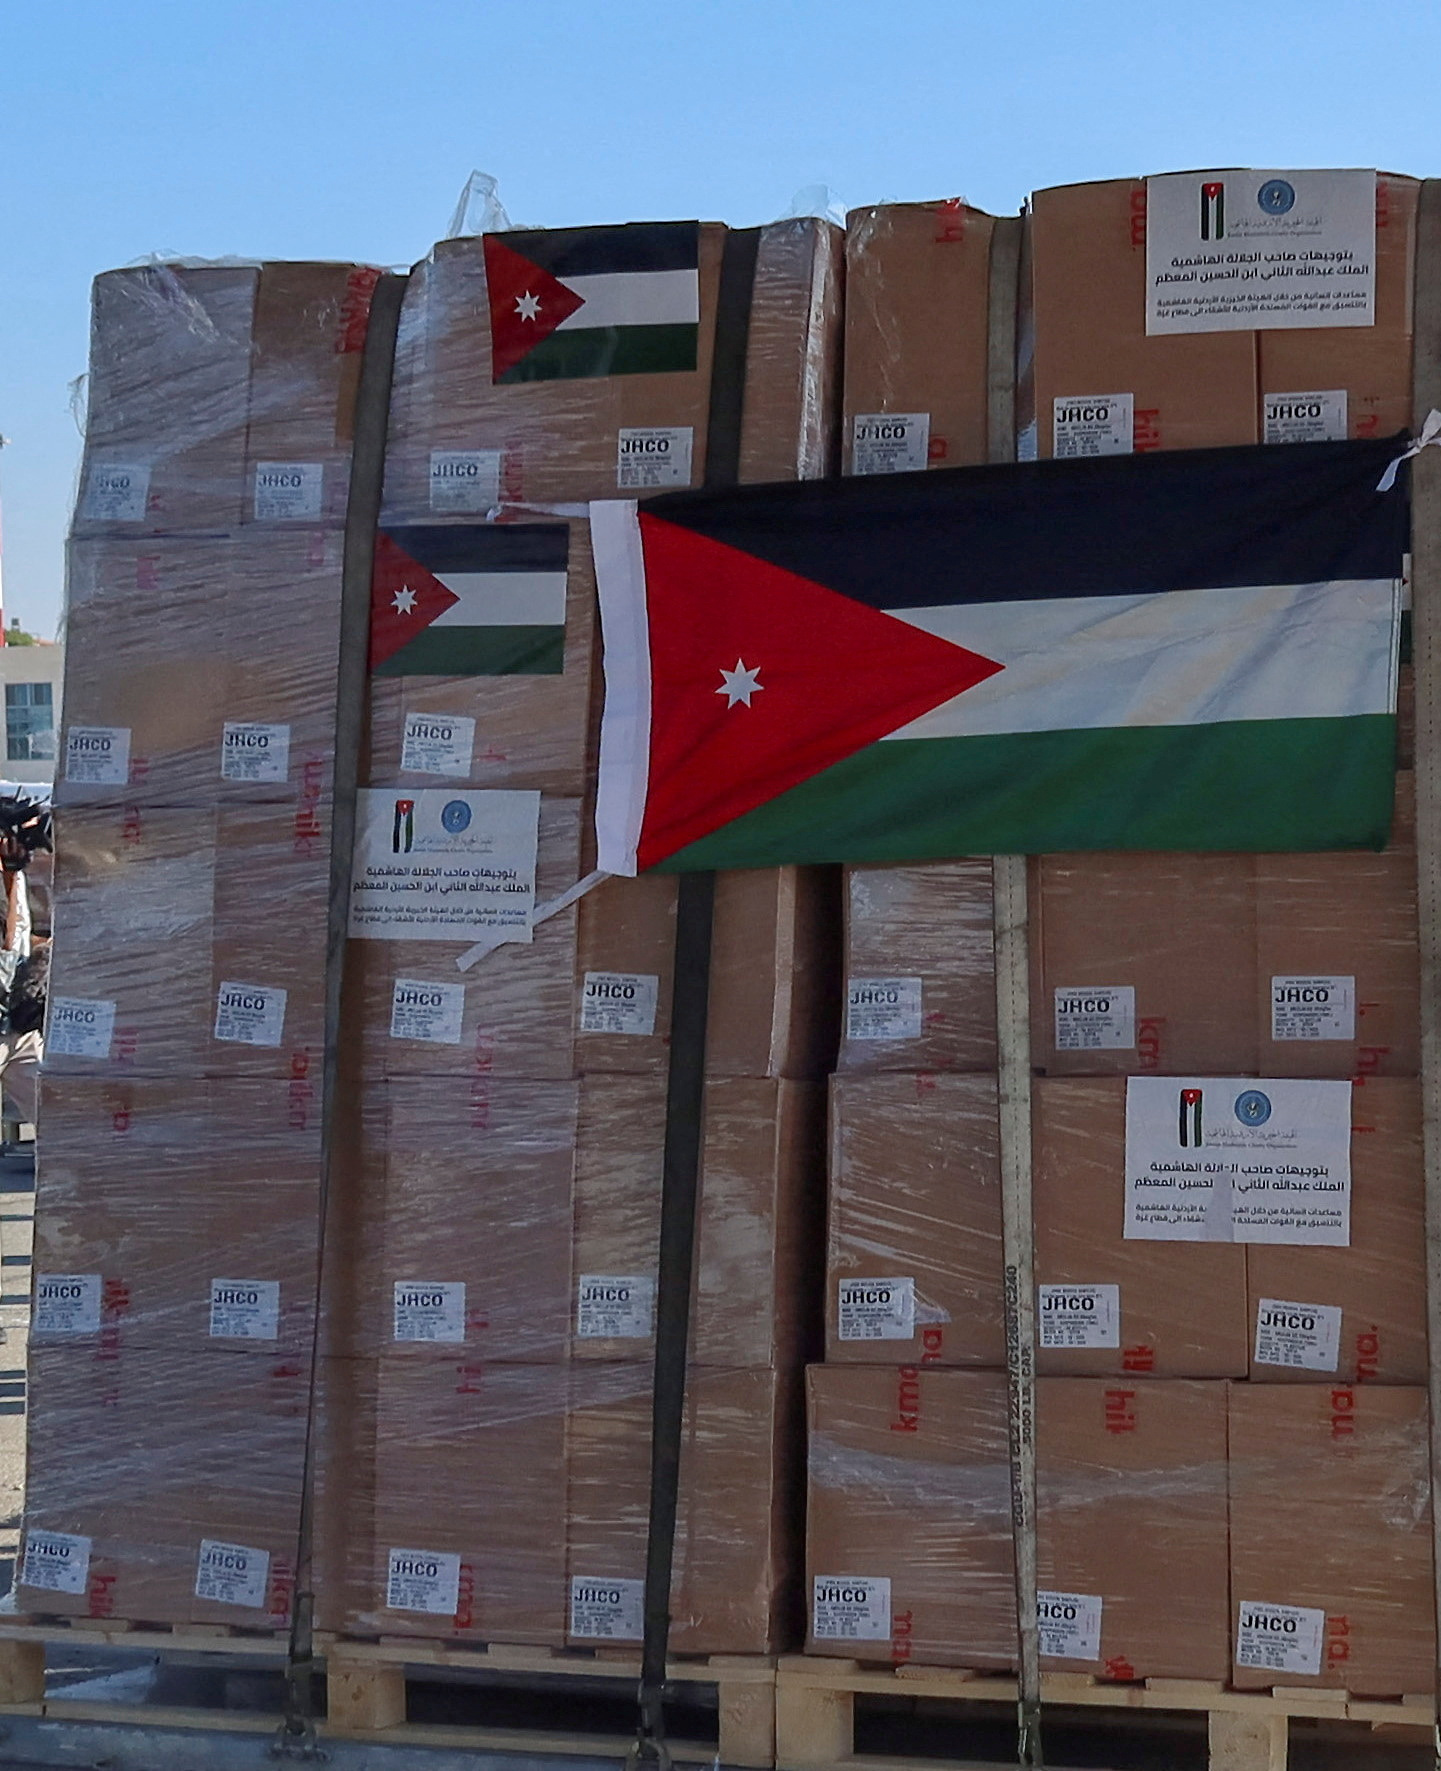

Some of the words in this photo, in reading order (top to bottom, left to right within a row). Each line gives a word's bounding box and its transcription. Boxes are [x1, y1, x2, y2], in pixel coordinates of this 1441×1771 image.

[1172, 254, 1223, 268] الهاشمية
[1227, 253, 1261, 264] الجلالة
[1265, 252, 1296, 264] صاحب
[1300, 250, 1352, 262] بتوجيهات
[1200, 269, 1238, 283] الحسين
[1242, 268, 1257, 280] ابن
[1261, 266, 1292, 280] الثاني
[1296, 263, 1333, 277] عبدالله
[1337, 266, 1368, 275] الملك
[1156, 272, 1196, 286] المعظم
[1057, 408, 1108, 423] JHCO
[1267, 405, 1320, 419] JHCO
[857, 427, 905, 440] JHCO
[621, 440, 669, 453] JHCO
[259, 475, 301, 487] JHCO
[407, 725, 452, 740] JHCO
[70, 738, 111, 751] JHCO
[225, 734, 268, 747] JHCO
[367, 866, 410, 876] الهاشمية
[444, 868, 469, 878] صاحب
[472, 868, 516, 880] بتوجيهات
[354, 882, 388, 892] المعظم
[390, 882, 422, 892] الحسين
[440, 881, 466, 895] الثاني
[469, 880, 501, 892] عبدالله
[503, 883, 529, 892] الملك
[586, 984, 635, 999] JHCO
[850, 990, 898, 1004] JHCO
[1275, 989, 1329, 1003] JHCO
[221, 994, 265, 1010] JHCO
[396, 991, 442, 1006] JHCO
[1058, 1000, 1109, 1013] JHCO
[54, 1010, 95, 1023] JHCO
[1150, 1160, 1201, 1173] الهاشمية
[1242, 1165, 1272, 1176] صاحب
[1276, 1165, 1328, 1178] بتوجيهات
[1135, 1177, 1175, 1190] المعظم
[1179, 1178, 1213, 1190] لحسين
[1238, 1178, 1269, 1194] الثاني
[1272, 1176, 1309, 1192] عبدالله
[1313, 1181, 1344, 1192] الملك
[39, 1286, 81, 1299] JHCO
[214, 1291, 257, 1304] JHCO
[582, 1289, 629, 1302] JHCO
[842, 1291, 890, 1304] JHCO
[397, 1295, 442, 1307] JHCO
[1043, 1298, 1094, 1311] JHCO
[1261, 1312, 1315, 1330] JHCO
[202, 1552, 246, 1570] JHCO
[392, 1560, 437, 1577] JHCO
[575, 1588, 620, 1604] JHCO
[817, 1590, 866, 1603] JHCO
[1037, 1605, 1076, 1619] HCO
[1242, 1615, 1296, 1633] JHCO
